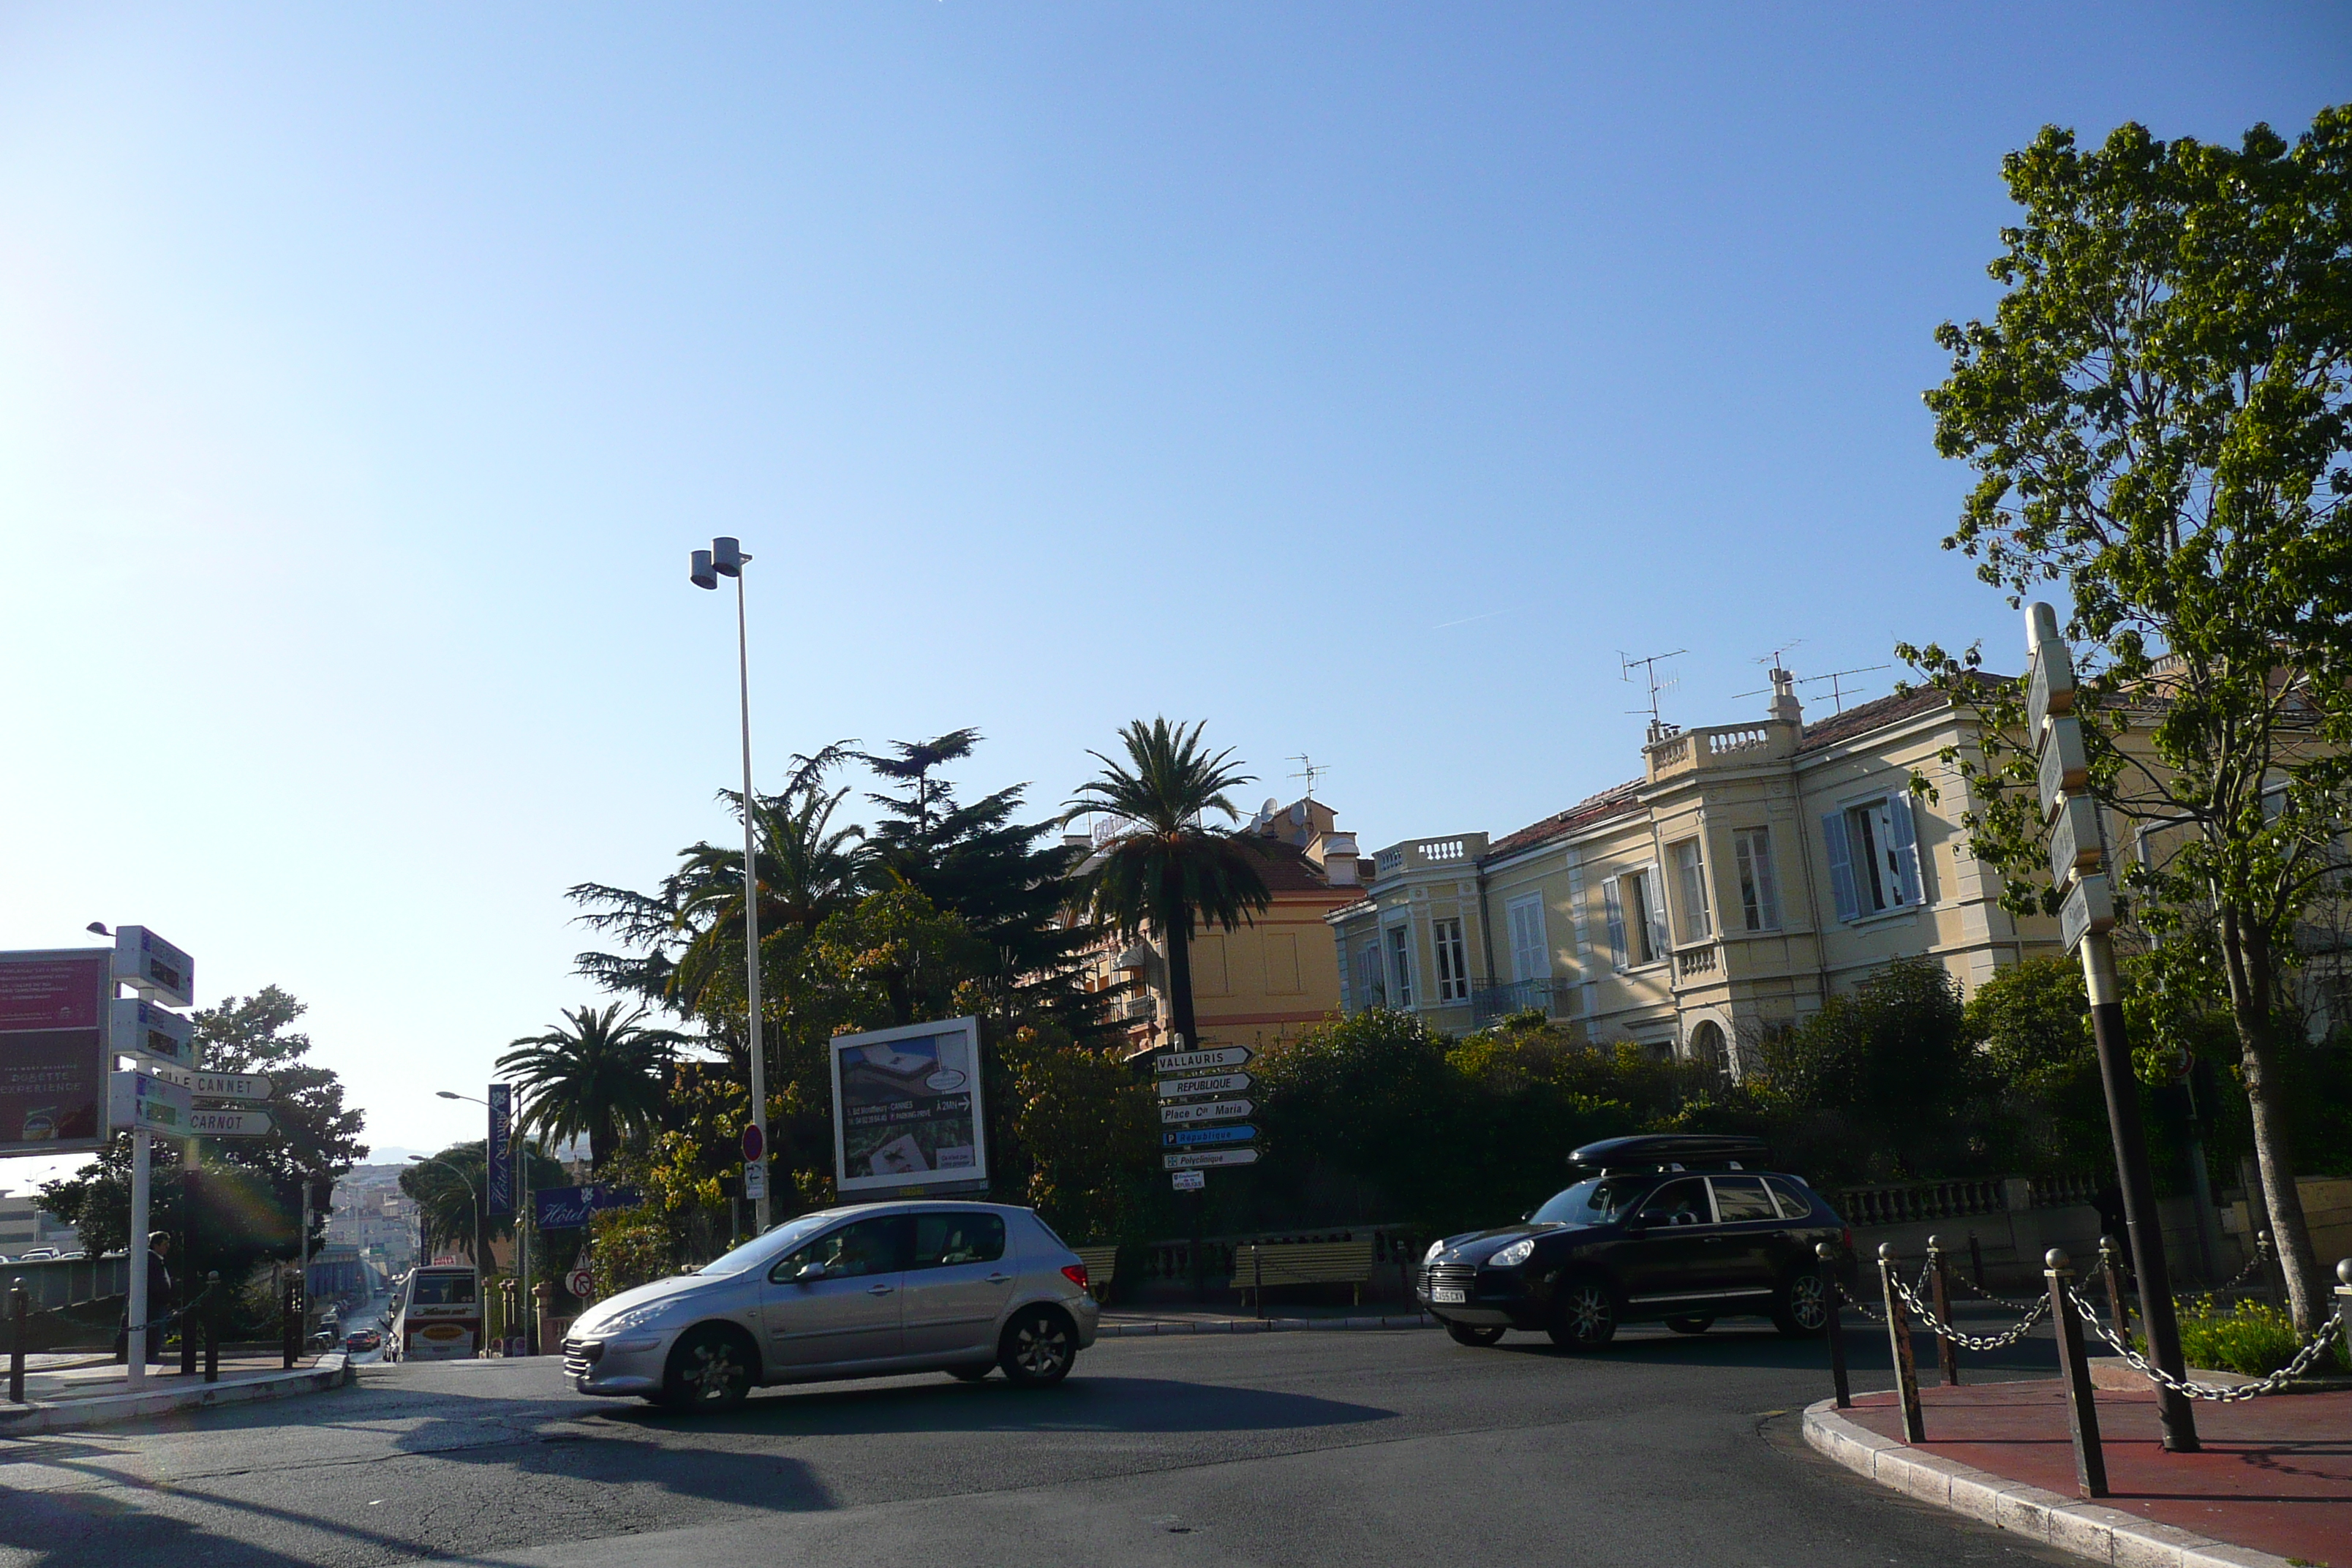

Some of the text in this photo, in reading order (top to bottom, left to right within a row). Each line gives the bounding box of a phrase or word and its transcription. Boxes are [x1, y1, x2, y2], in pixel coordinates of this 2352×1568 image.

[1159, 1053, 1224, 1068] VALLAURIS
[198, 1078, 252, 1093] CANNET
[890, 1101, 913, 1112] CANNES
[1164, 1109, 1190, 1120] Place
[1215, 1104, 1243, 1115] Maria
[192, 1115, 243, 1130] CARNOT
[1180, 1131, 1232, 1142] République
[1180, 1155, 1224, 1164] Polyclinique
[491, 1158, 509, 1208] Hôtel
[539, 1202, 591, 1226] Hôtel
